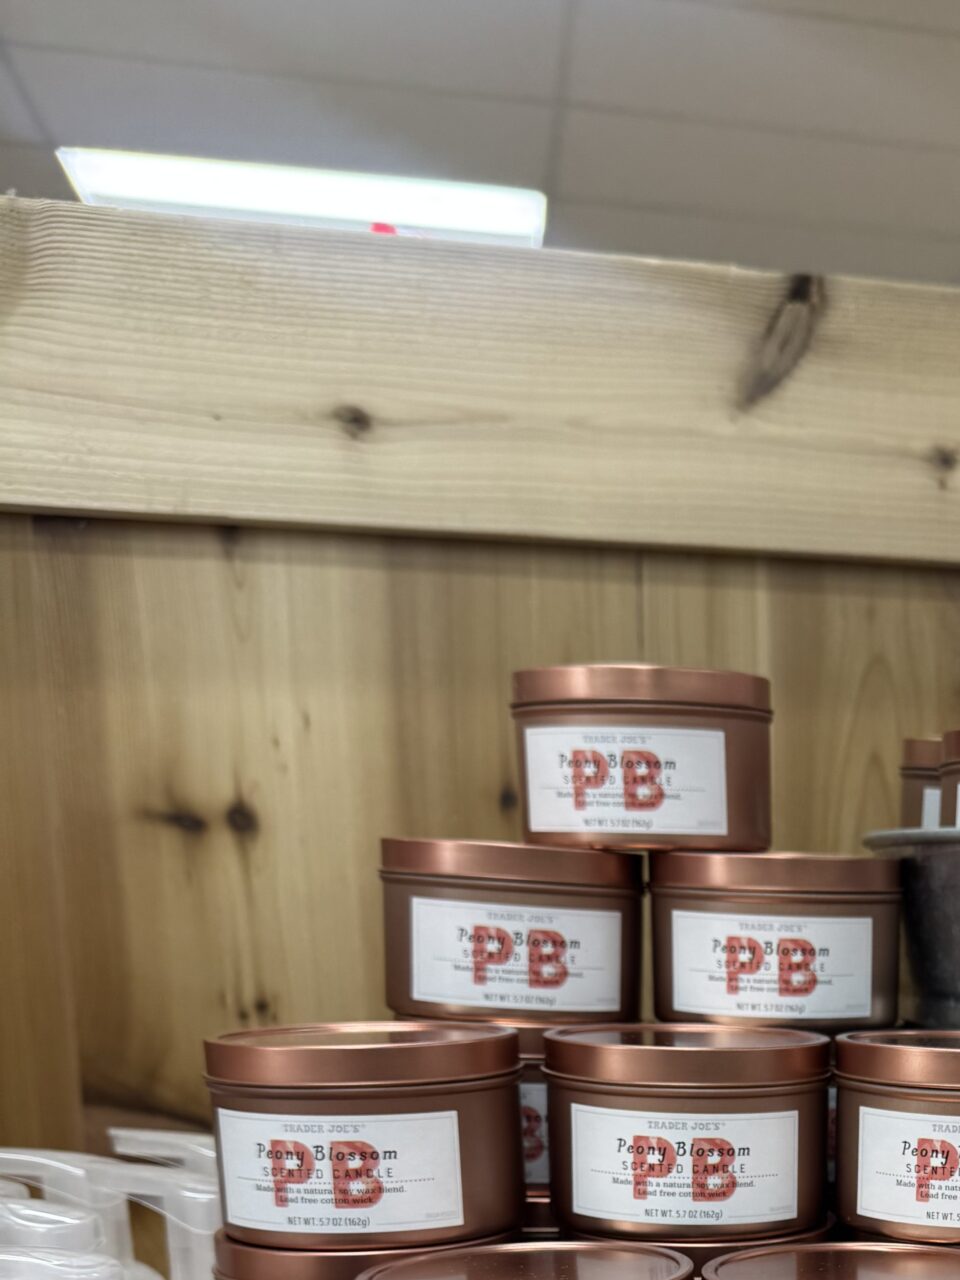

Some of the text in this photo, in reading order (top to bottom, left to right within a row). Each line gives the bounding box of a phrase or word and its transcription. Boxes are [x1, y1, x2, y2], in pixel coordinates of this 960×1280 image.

[647, 1121, 689, 1130] TRADER
[256, 1143, 399, 1168] Peony Blossom
[617, 1137, 751, 1163] Peony Blossom
[901, 1140, 951, 1166] Peony
[263, 1167, 394, 1179] SCENTED CANDLE
[622, 1161, 746, 1174] SCENTED CANDLE
